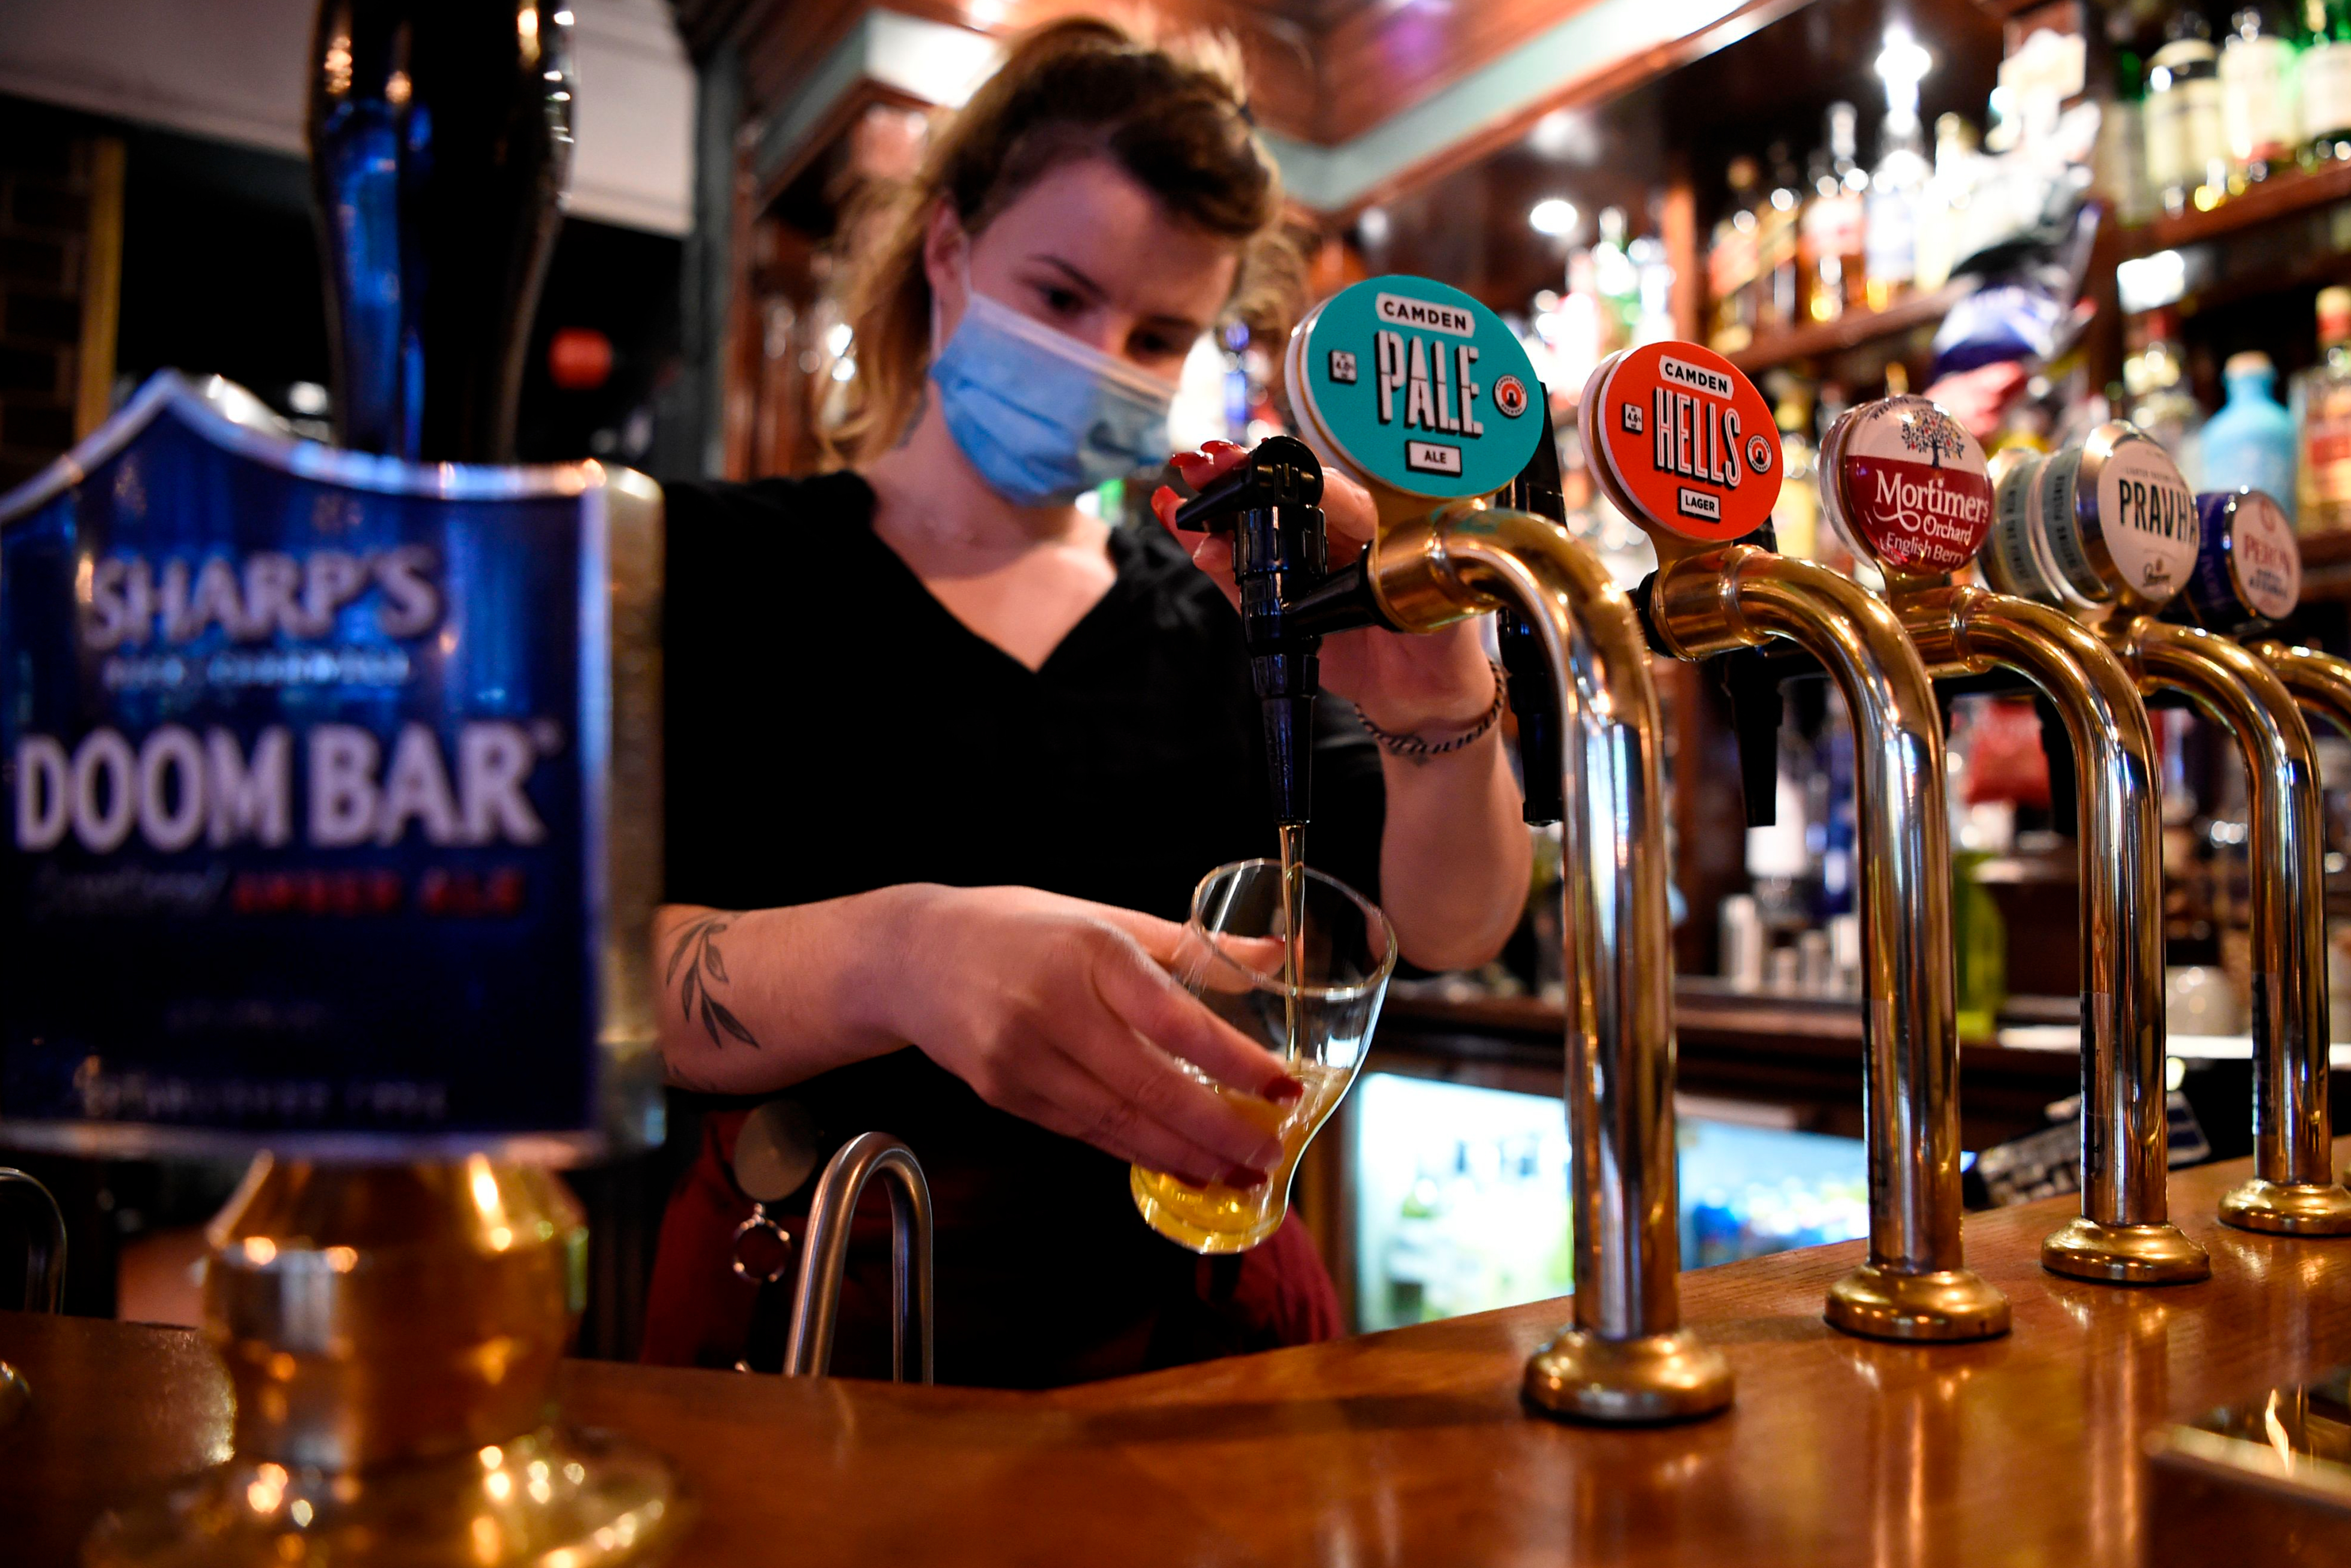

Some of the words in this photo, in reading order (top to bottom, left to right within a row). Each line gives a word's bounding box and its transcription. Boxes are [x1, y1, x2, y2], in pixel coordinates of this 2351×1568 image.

[1384, 301, 1466, 331] CAMDEN
[1375, 329, 1484, 438] PALE
[1665, 362, 1728, 394] CAMDEN
[1424, 445, 1446, 465] ALE
[1654, 385, 1741, 489] HELLS
[1684, 494, 1715, 512] LAGER
[2119, 478, 2198, 547] PRAVHA
[1923, 514, 1974, 544] Orchard
[1886, 531, 1931, 559] English
[1933, 544, 1964, 568] Berry
[86, 545, 442, 649] SHARP'S
[16, 727, 293, 852] DOOM
